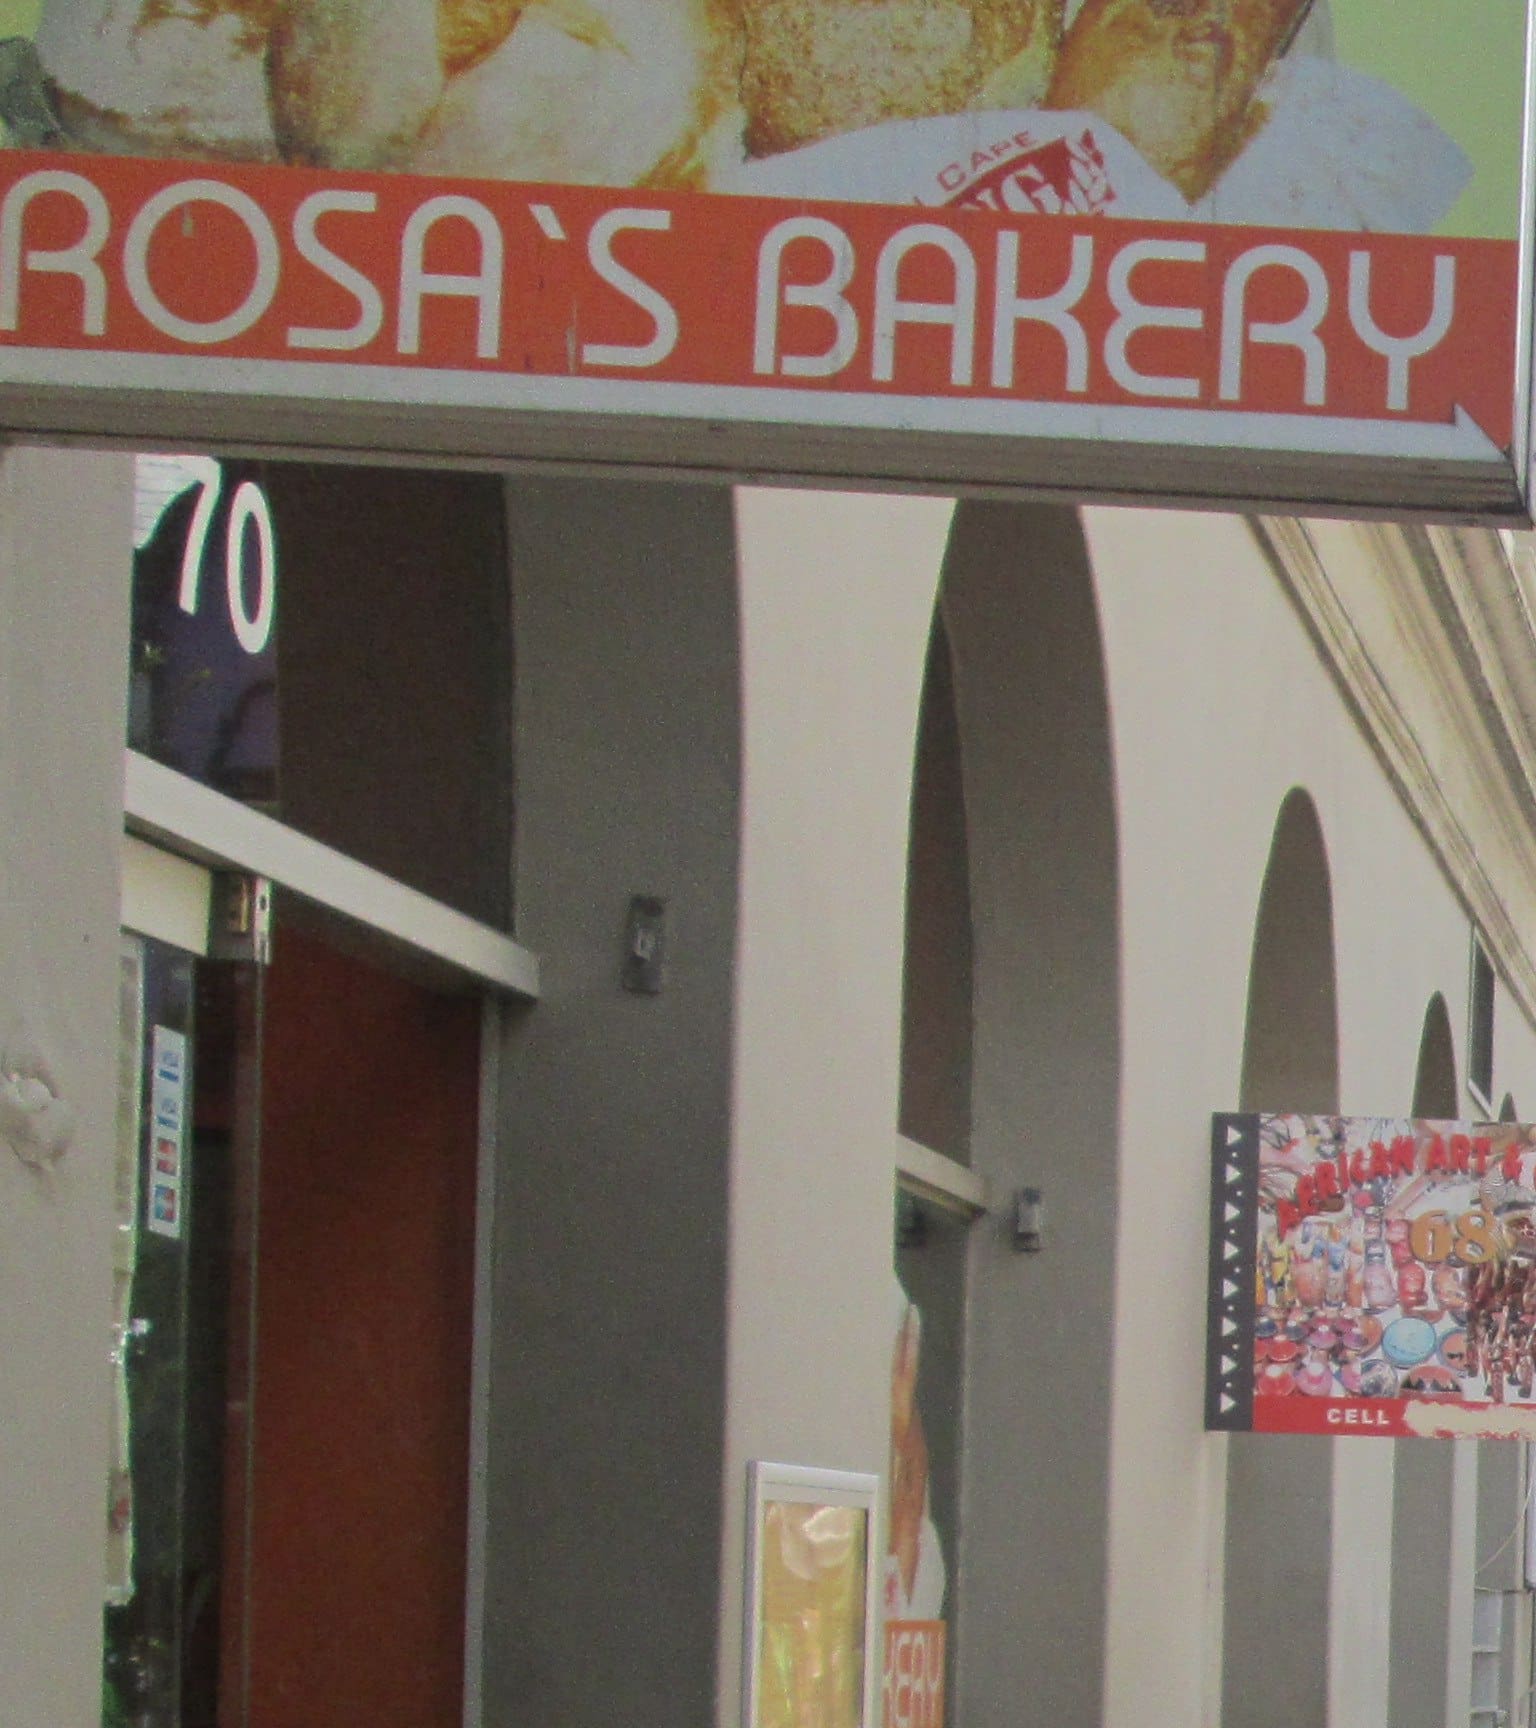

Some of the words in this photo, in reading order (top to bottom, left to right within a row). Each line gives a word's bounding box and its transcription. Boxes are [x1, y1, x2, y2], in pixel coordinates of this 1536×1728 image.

[753, 215, 1456, 412] BAKERY
[133, 454, 275, 655] 70
[1425, 1132, 1493, 1177] ART
[1410, 1210, 1499, 1264] 68
[1326, 1408, 1390, 1426] CELL
